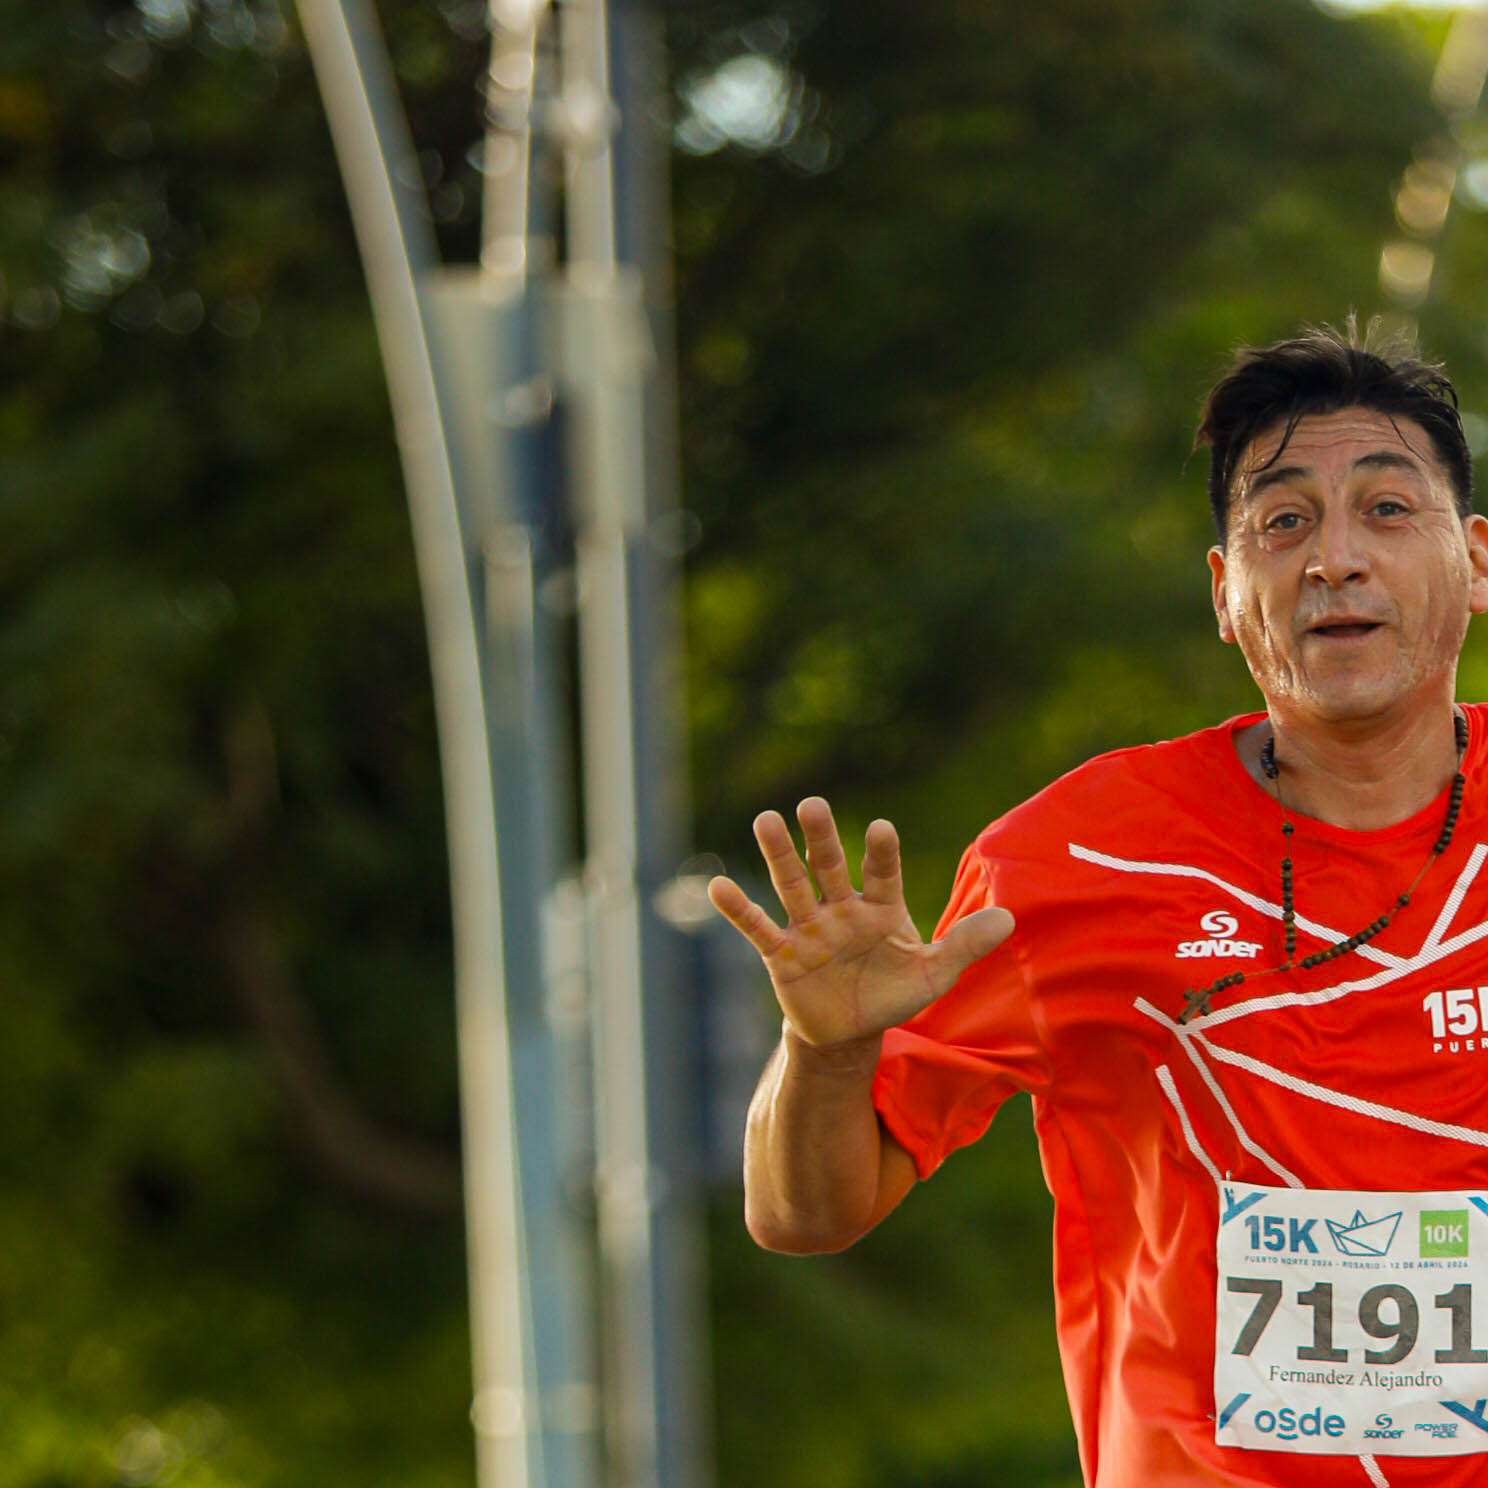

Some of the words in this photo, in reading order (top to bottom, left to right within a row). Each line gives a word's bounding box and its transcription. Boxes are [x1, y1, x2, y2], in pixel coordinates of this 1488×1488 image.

[1244, 1215, 1320, 1254] 15K
[1424, 1223, 1464, 1245] 10K
[1244, 1255, 1278, 1264] PUERTO
[1281, 1257, 1308, 1265] NORTE
[1403, 1261, 1414, 1269] DE
[1418, 1261, 1443, 1269] ABRIL
[1226, 1276, 1488, 1365] 7191
[1269, 1365, 1354, 1385] Fernandez
[1360, 1370, 1443, 1391] Alejandro
[1254, 1406, 1346, 1439] osde
[1414, 1423, 1458, 1431] POWER
